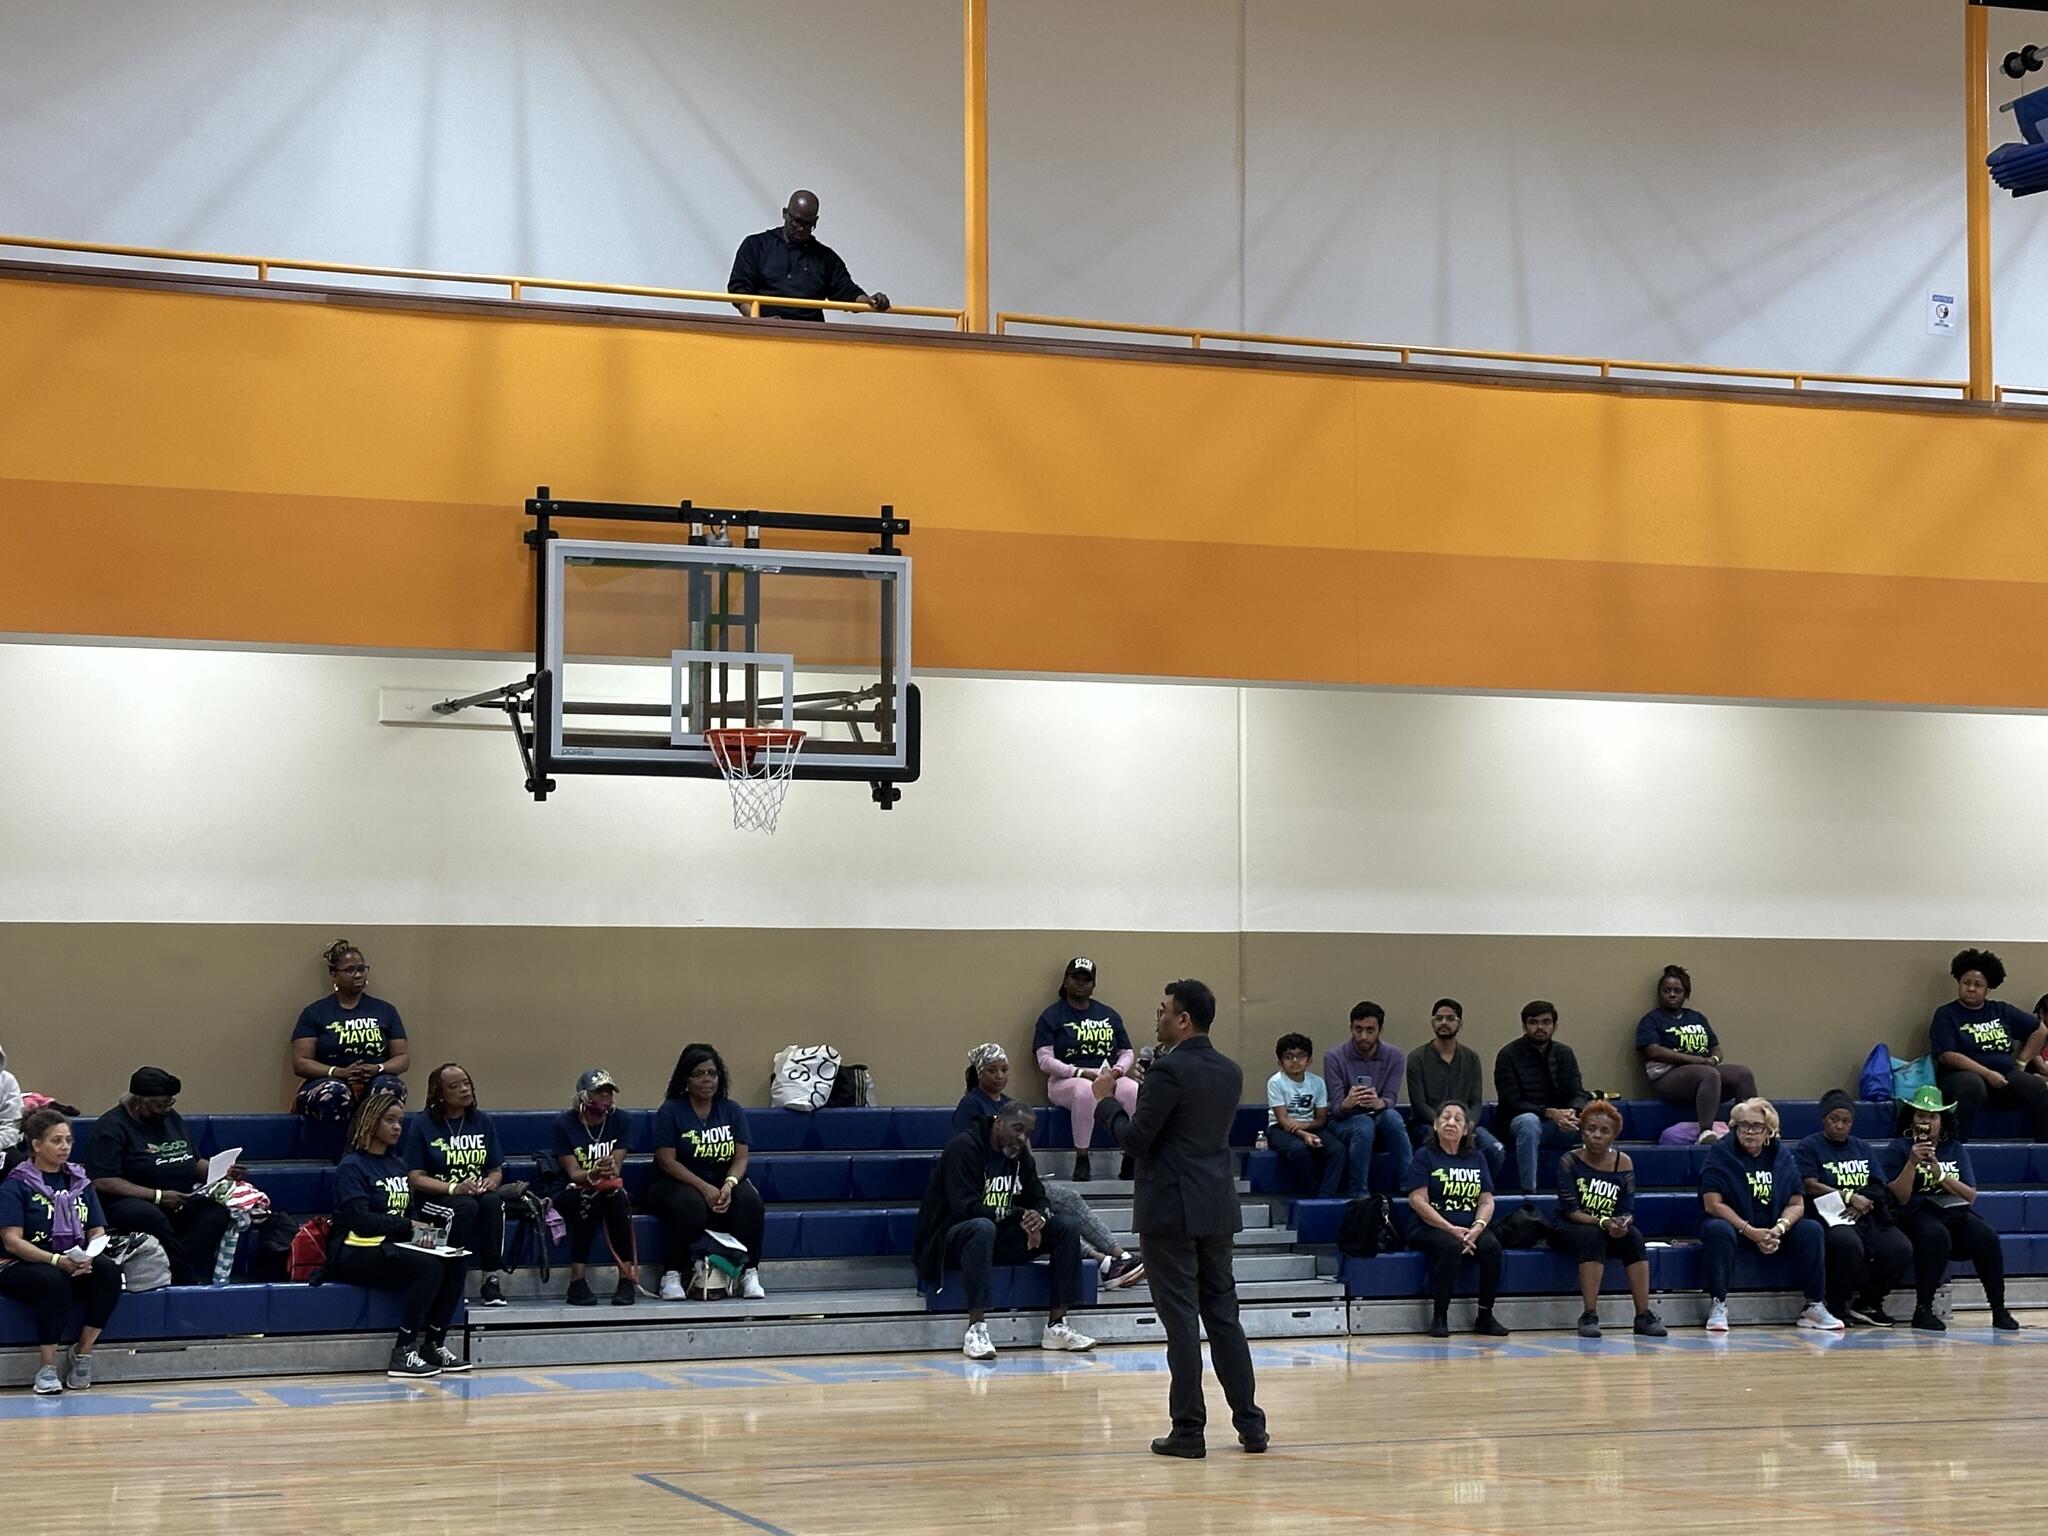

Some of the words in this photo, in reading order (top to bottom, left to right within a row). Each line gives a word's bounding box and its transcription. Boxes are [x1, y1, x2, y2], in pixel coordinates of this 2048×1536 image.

[345, 1017, 379, 1031] MOVE
[1081, 1017, 1112, 1030] MOVE
[1973, 1018, 2003, 1033] MOVE
[339, 1028, 383, 1045] MAYOR
[1077, 1028, 1113, 1041] MAYOR
[1974, 1027, 2008, 1044] MAYOR
[450, 1134, 486, 1150] MOVE
[701, 1125, 734, 1144] MOVE
[446, 1149, 487, 1165] MAYOR
[694, 1140, 735, 1158] MAYOR
[1449, 1167, 1481, 1183] MOVE
[1837, 1159, 1870, 1175] MOVE
